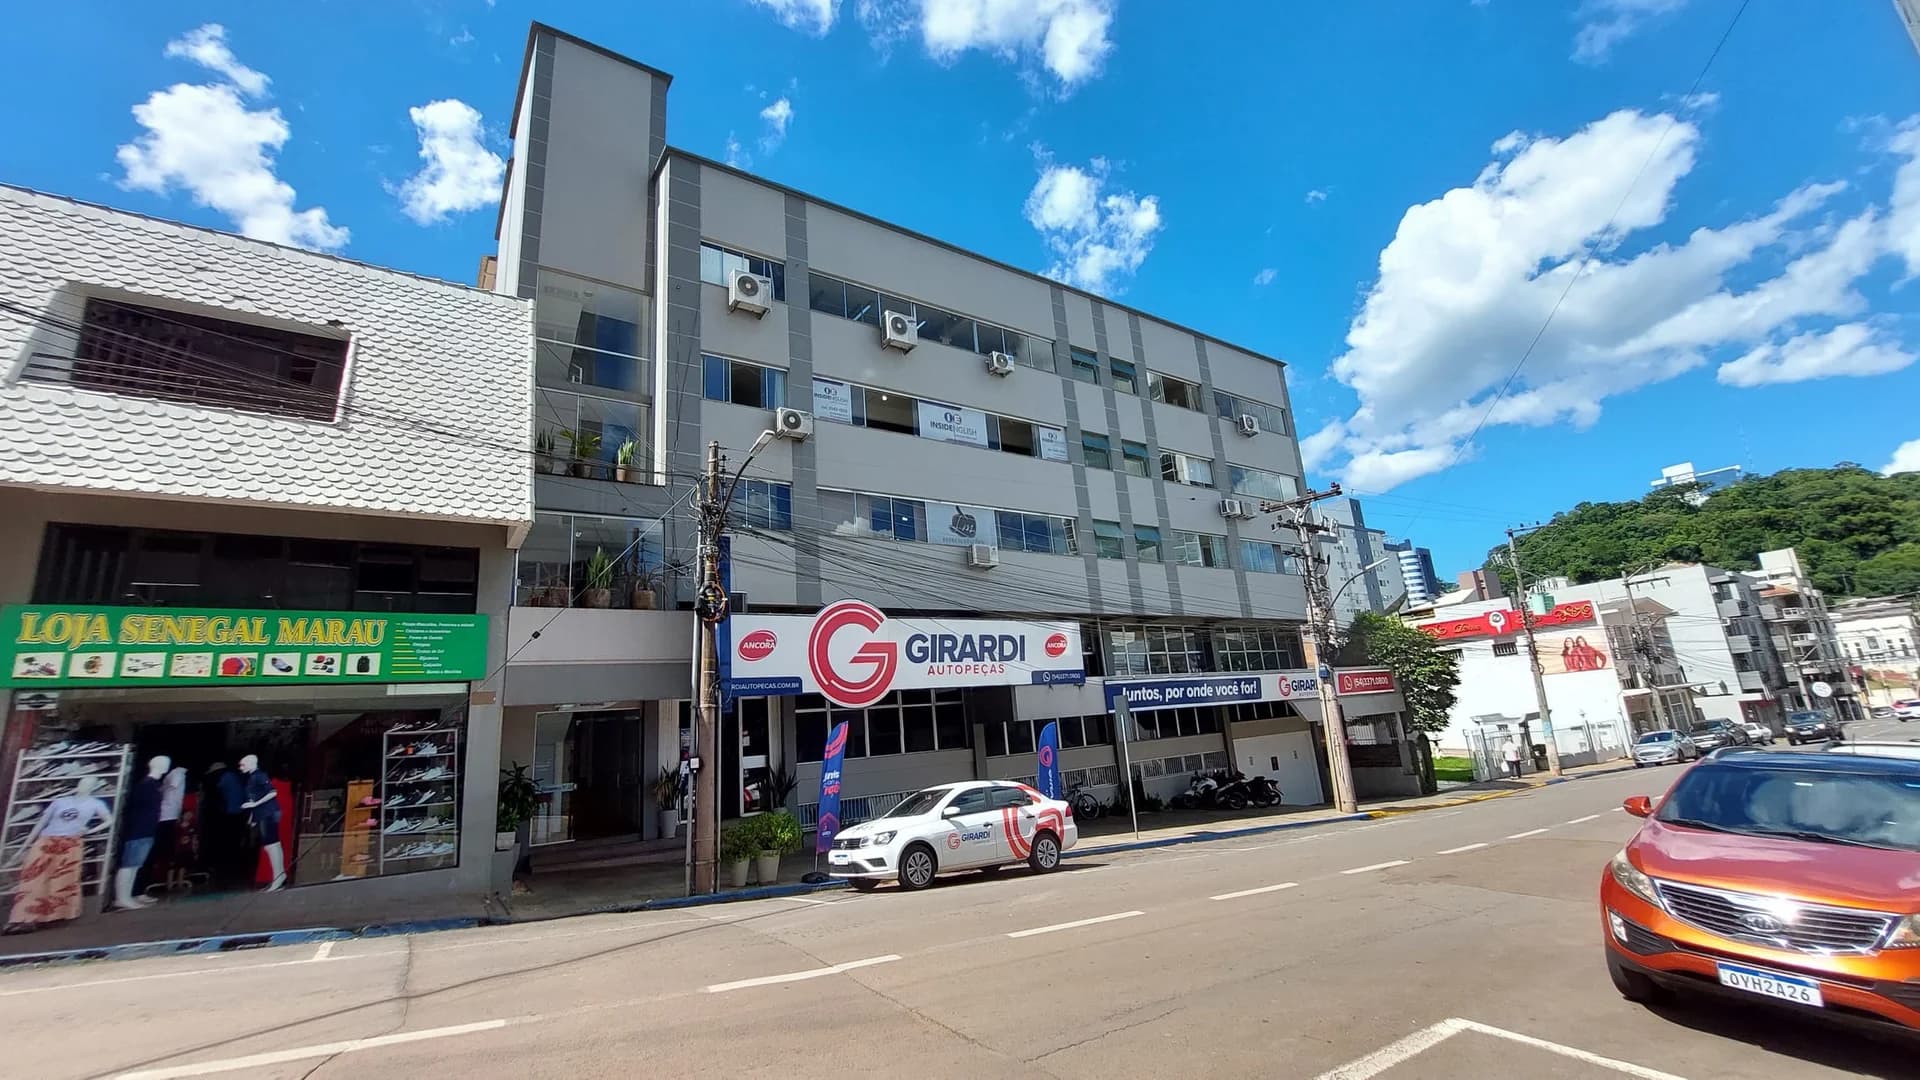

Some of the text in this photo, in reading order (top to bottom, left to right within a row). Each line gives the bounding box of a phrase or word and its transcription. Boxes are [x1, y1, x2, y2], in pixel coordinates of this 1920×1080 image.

[16, 612, 388, 650] LOJA SENEGAL MARAU
[743, 641, 776, 649] ANCORA
[905, 633, 1025, 664] GIRARDI
[927, 664, 1005, 677] AUTOPEÇAS
[1165, 686, 1184, 702] por
[1186, 683, 1213, 698] onde
[1215, 680, 1239, 696] você
[1240, 680, 1257, 694] for!
[1291, 679, 1319, 692] GIRAR
[961, 831, 991, 842] GIRARDI
[1729, 972, 1810, 1002] OYH2A26
